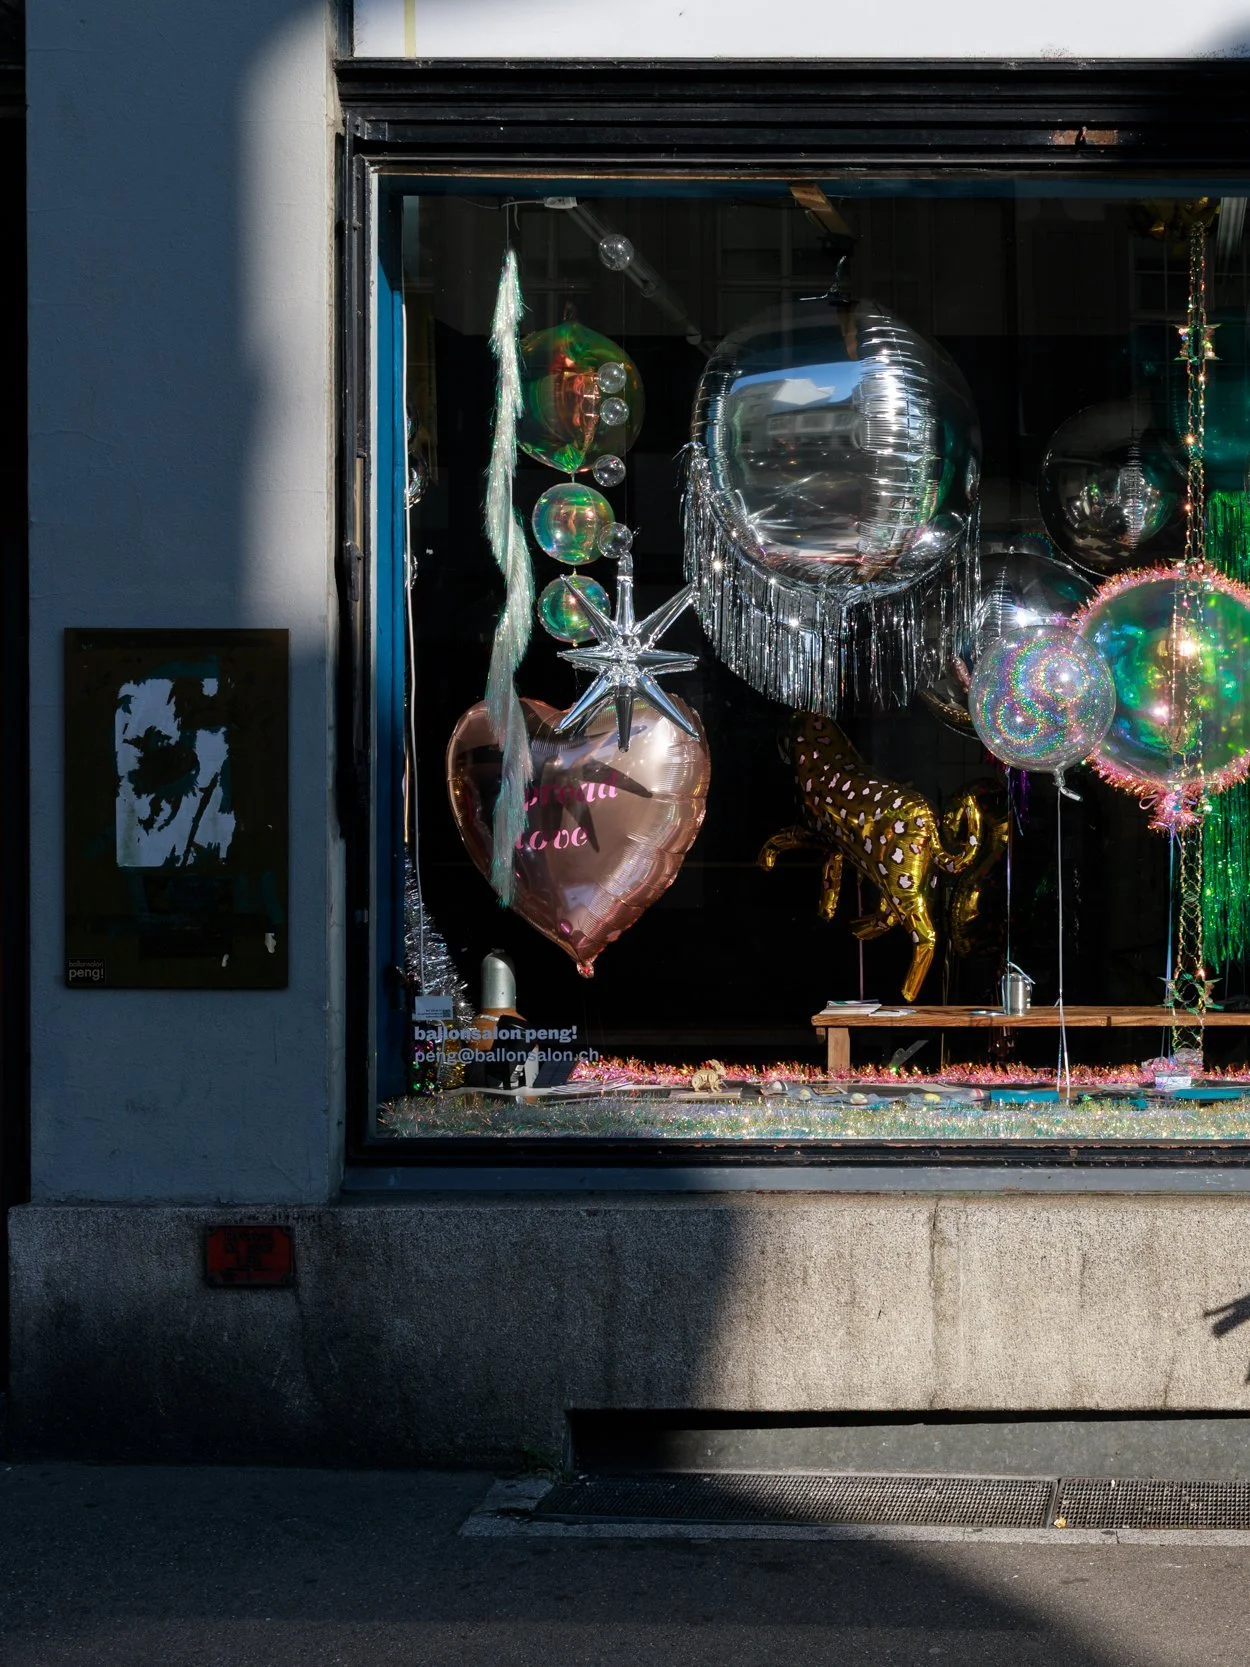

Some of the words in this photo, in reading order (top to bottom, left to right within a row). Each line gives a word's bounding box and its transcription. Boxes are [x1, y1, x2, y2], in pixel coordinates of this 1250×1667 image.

[69, 968, 104, 982] peng!
[414, 1026, 522, 1040] ballonsalon
[525, 1025, 578, 1043] peng!
[414, 1047, 599, 1066] peng@ballonsalon.ch
